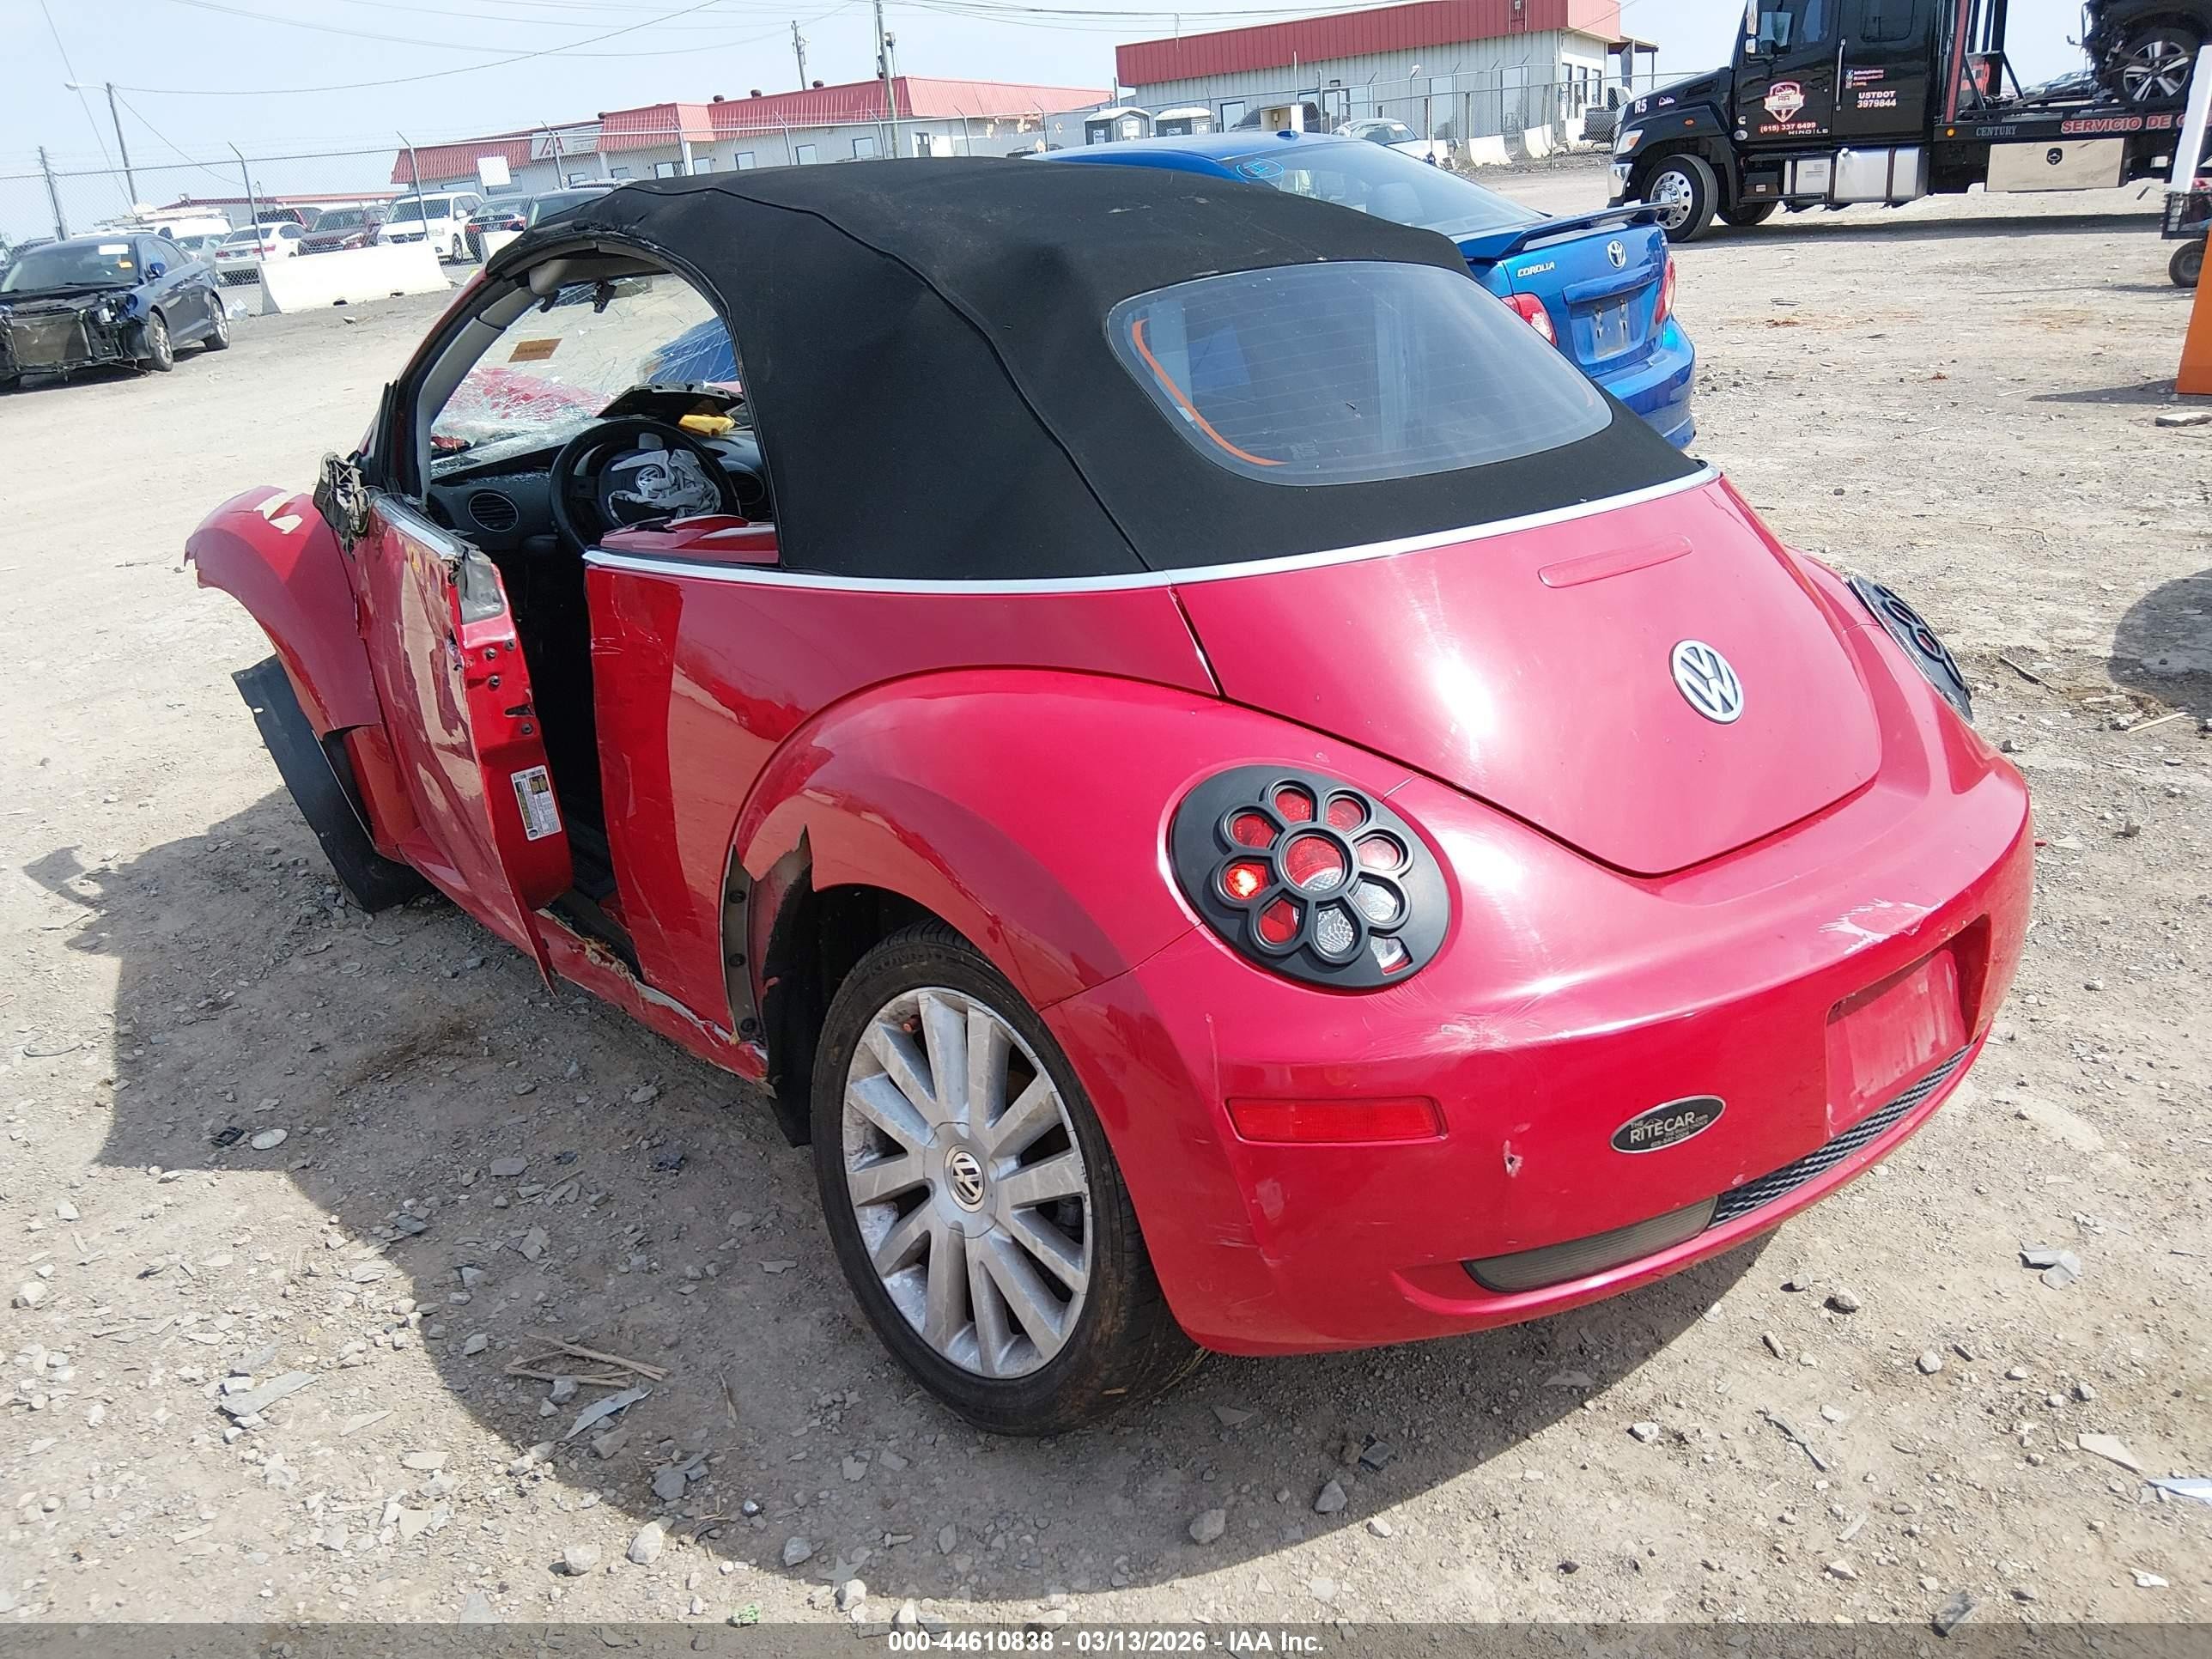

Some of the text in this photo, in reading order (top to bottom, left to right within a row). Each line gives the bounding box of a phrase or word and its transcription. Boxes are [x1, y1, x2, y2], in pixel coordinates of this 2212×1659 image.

[1858, 90, 1896, 99] USTDOT
[1634, 98, 1648, 114] R5
[1856, 99, 1897, 108] 3979844
[1759, 125, 1780, 134] (615)
[2061, 116, 2142, 134] SERVICIO
[2146, 114, 2172, 130] DE
[1976, 125, 2018, 137] CENTURY
[1516, 261, 1555, 278] COROLLA
